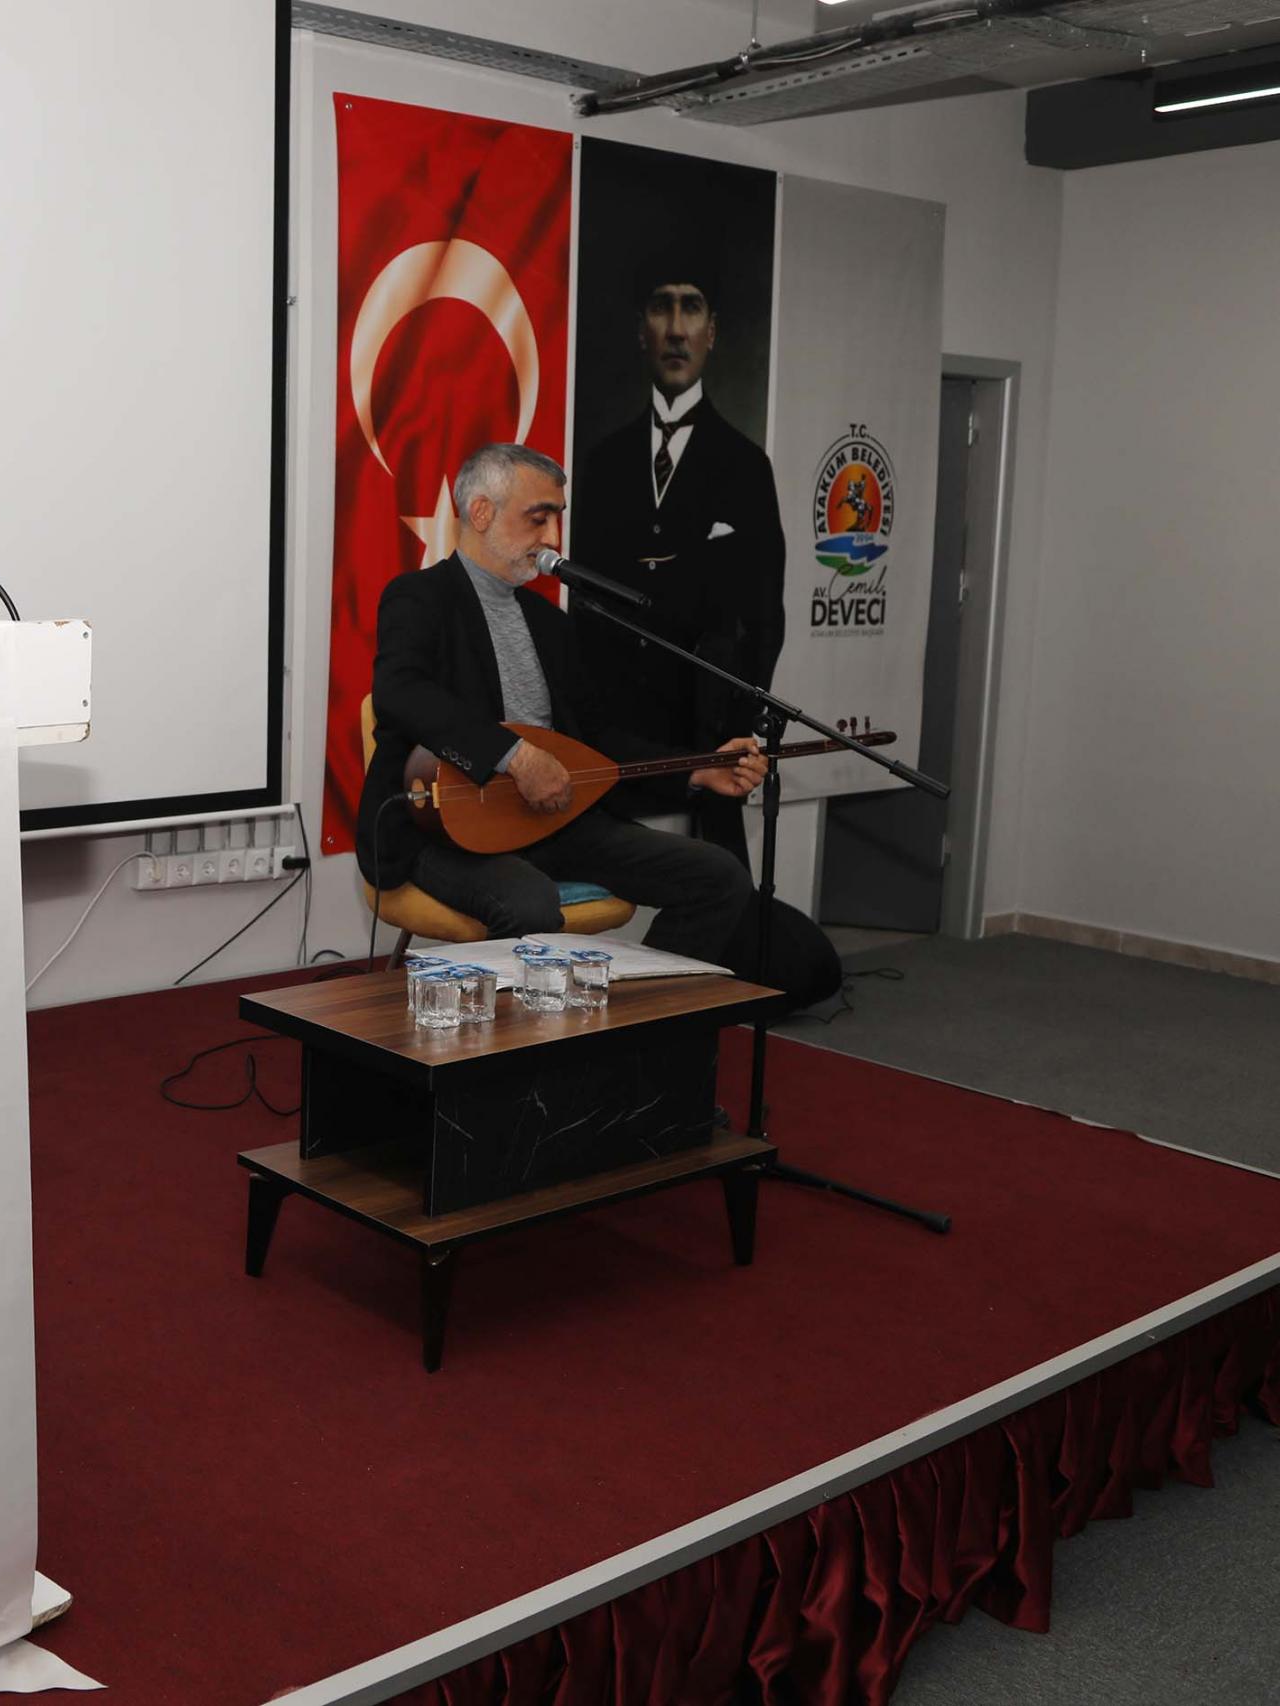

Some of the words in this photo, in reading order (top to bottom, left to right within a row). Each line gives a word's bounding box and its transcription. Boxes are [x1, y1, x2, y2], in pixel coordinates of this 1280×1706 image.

[817, 452, 847, 534] ATAKUM
[852, 446, 893, 536] BELEDİYESİ
[810, 590, 887, 627] DEVECİ
